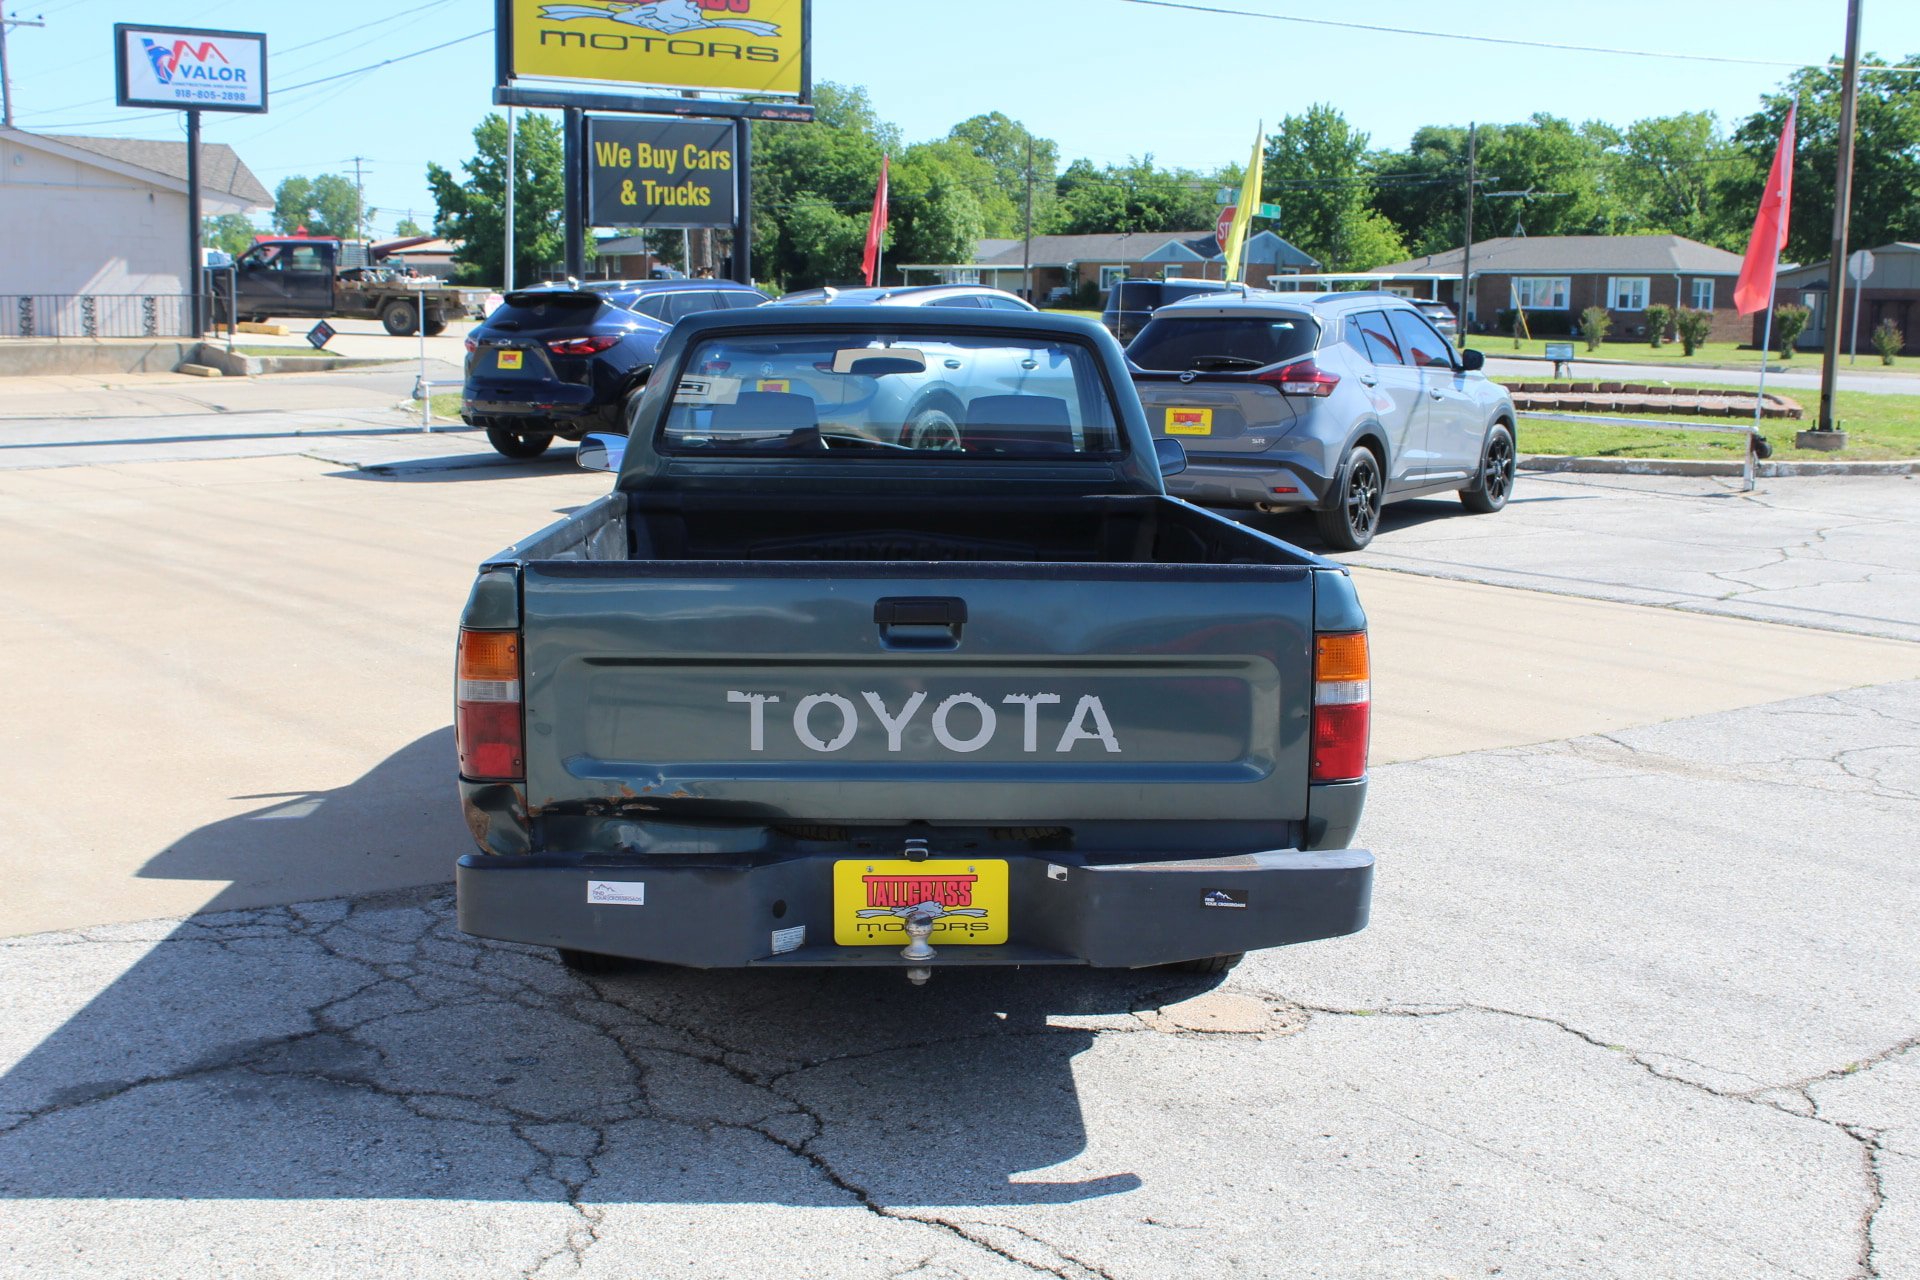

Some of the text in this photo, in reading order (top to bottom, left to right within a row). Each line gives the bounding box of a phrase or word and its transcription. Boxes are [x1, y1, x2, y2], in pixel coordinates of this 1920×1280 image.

[540, 29, 779, 63] MOTORS
[179, 64, 247, 82] VALOR
[595, 141, 731, 174] We Buy Cars
[620, 180, 710, 207] & Trucks
[727, 690, 1122, 752] TOYOTA
[862, 875, 978, 907] TALLGRASS
[857, 922, 989, 932] MOORS
